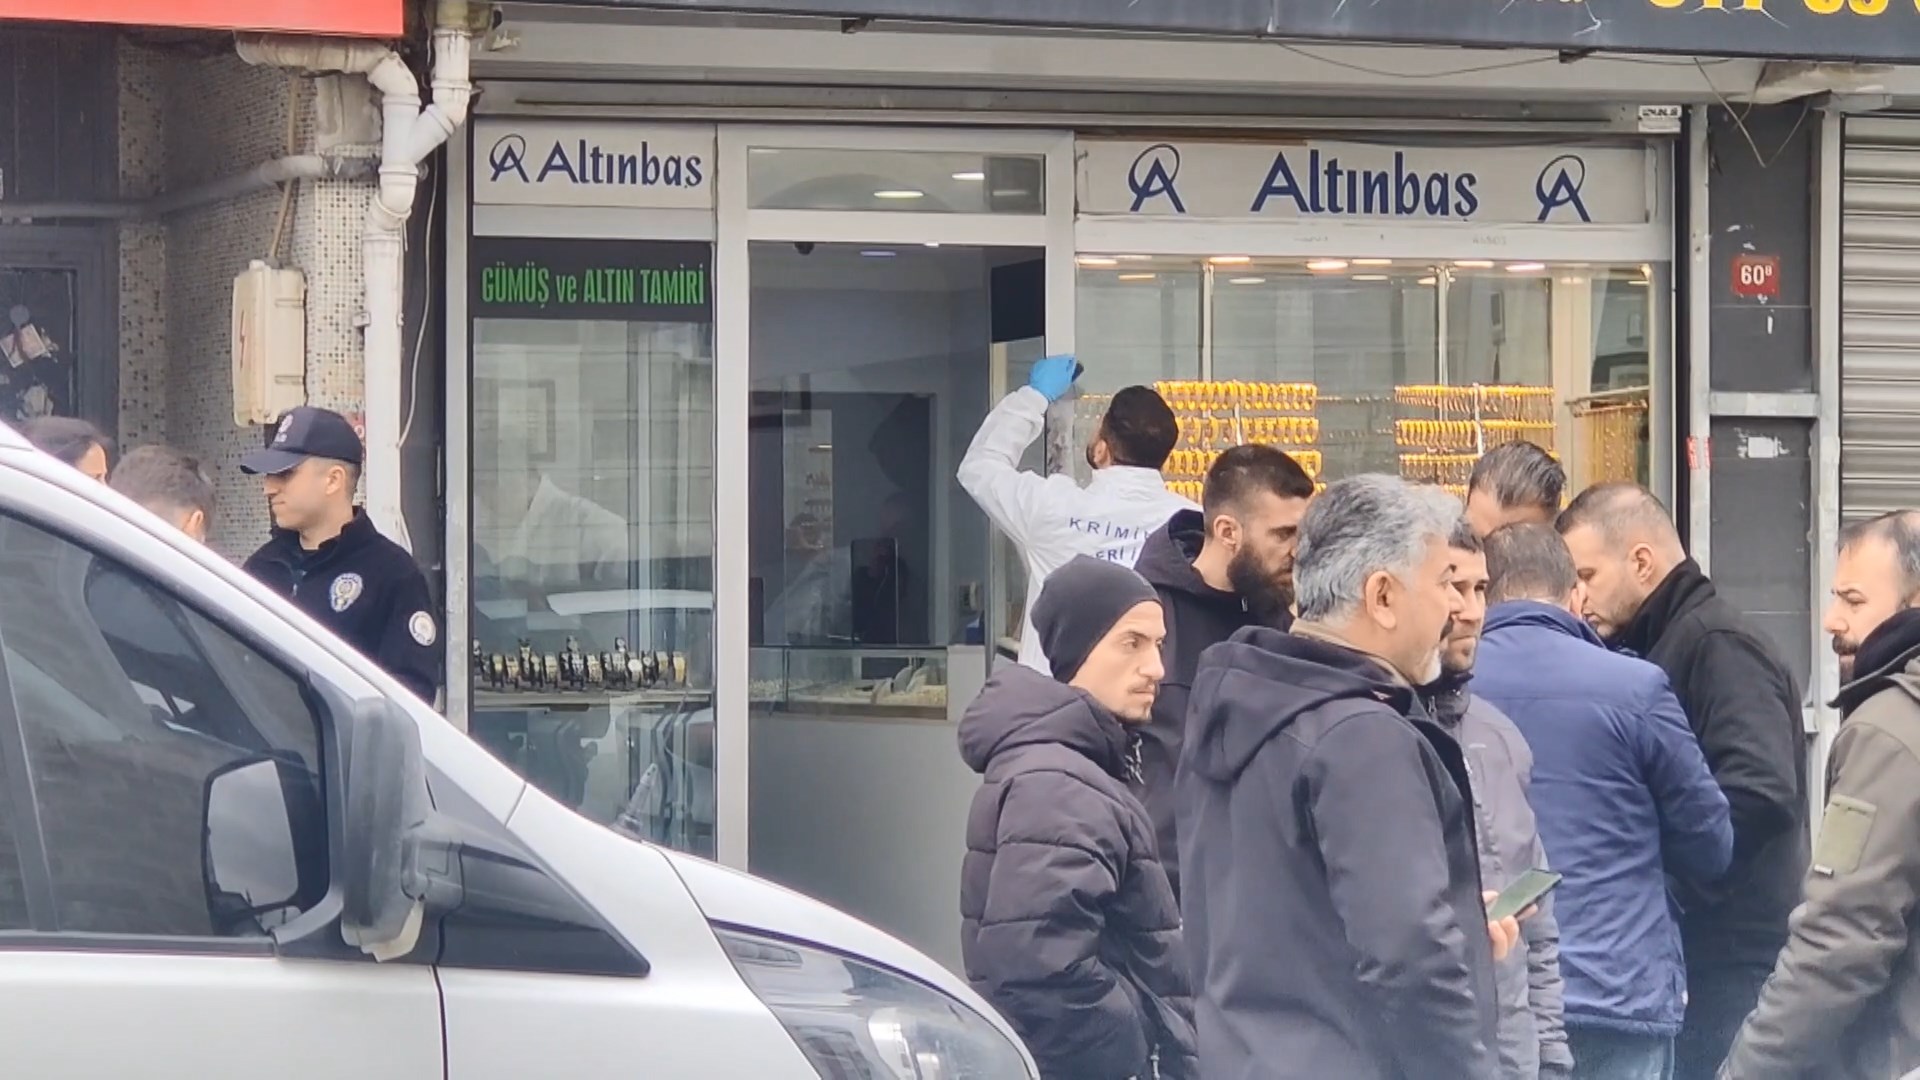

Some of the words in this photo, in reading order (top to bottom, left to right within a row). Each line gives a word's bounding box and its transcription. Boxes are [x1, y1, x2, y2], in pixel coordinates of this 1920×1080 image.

[482, 261, 550, 309] GÜMÜŞ
[555, 275, 578, 303] ve
[583, 268, 635, 303] ALTIN
[641, 264, 704, 305] TAMİRİ
